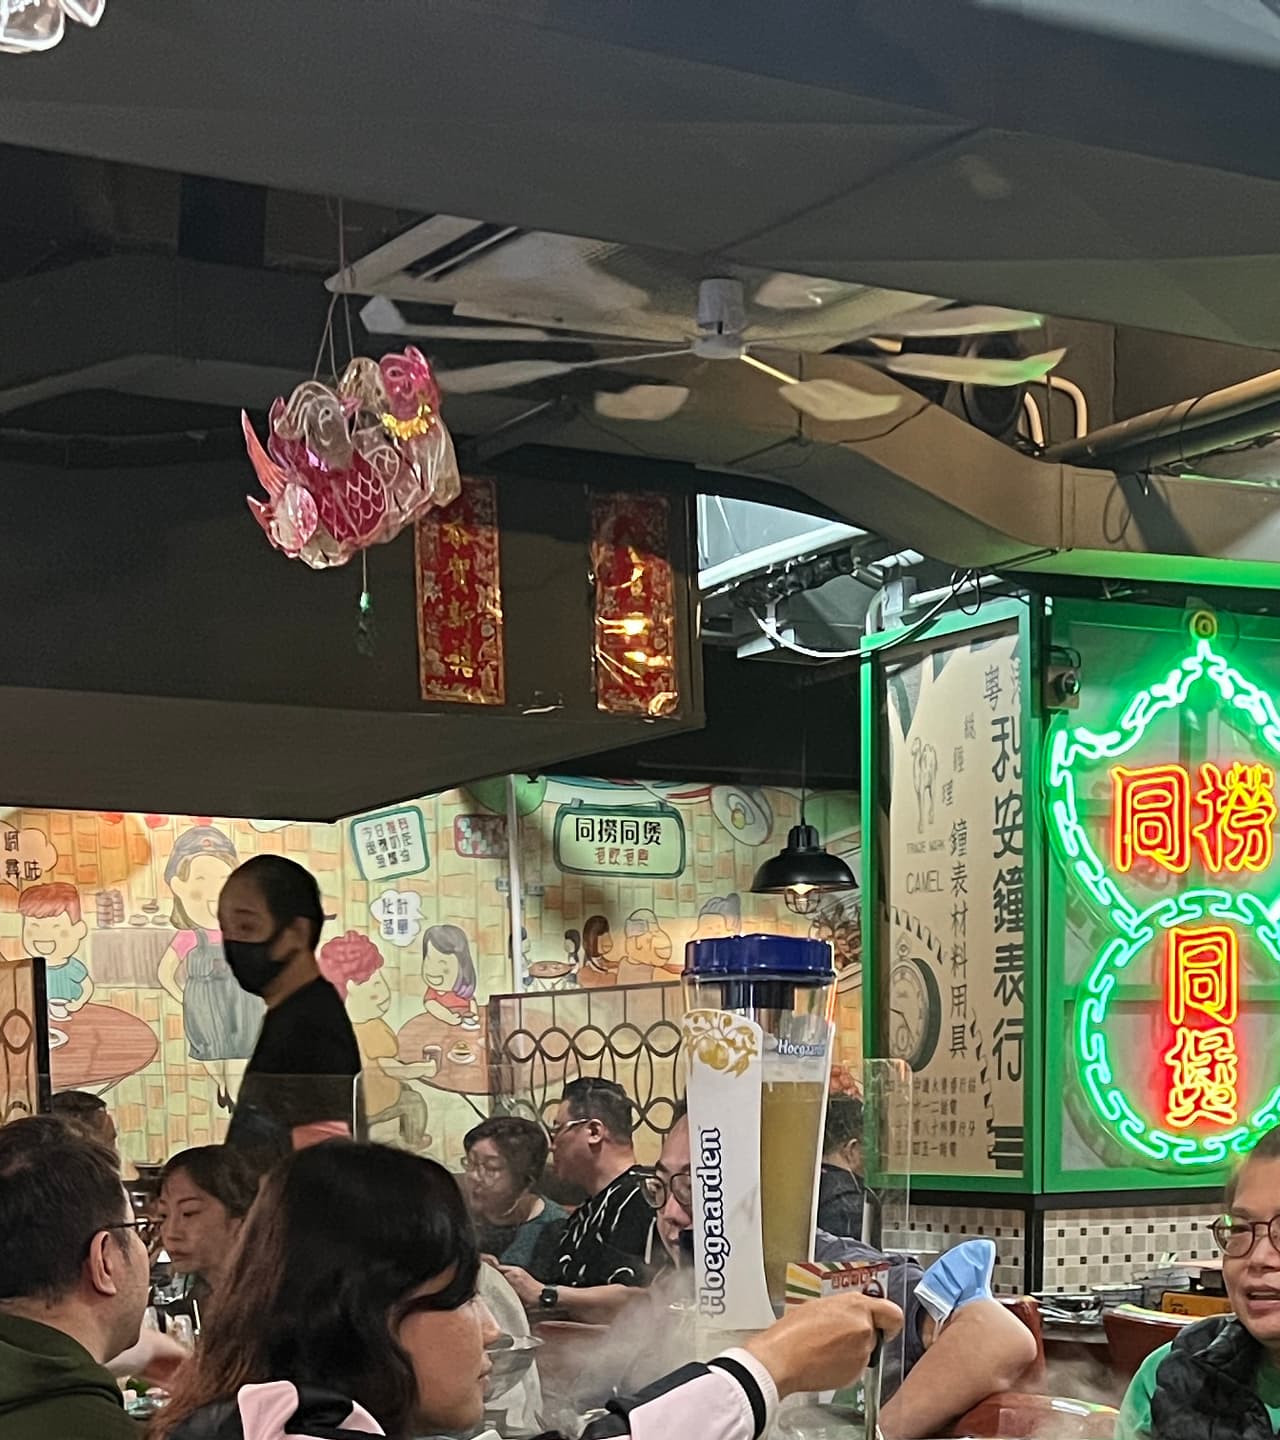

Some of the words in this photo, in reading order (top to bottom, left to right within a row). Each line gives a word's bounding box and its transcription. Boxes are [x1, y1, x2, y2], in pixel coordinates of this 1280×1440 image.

[574, 817, 662, 846] 同撈同煲
[906, 870, 945, 894] CAMEL
[1110, 763, 1280, 873] 同撈
[948, 817, 969, 1060] 鐘表材料用具
[1165, 924, 1239, 1128] 同煲
[696, 1127, 731, 1318] Hoegaarden
